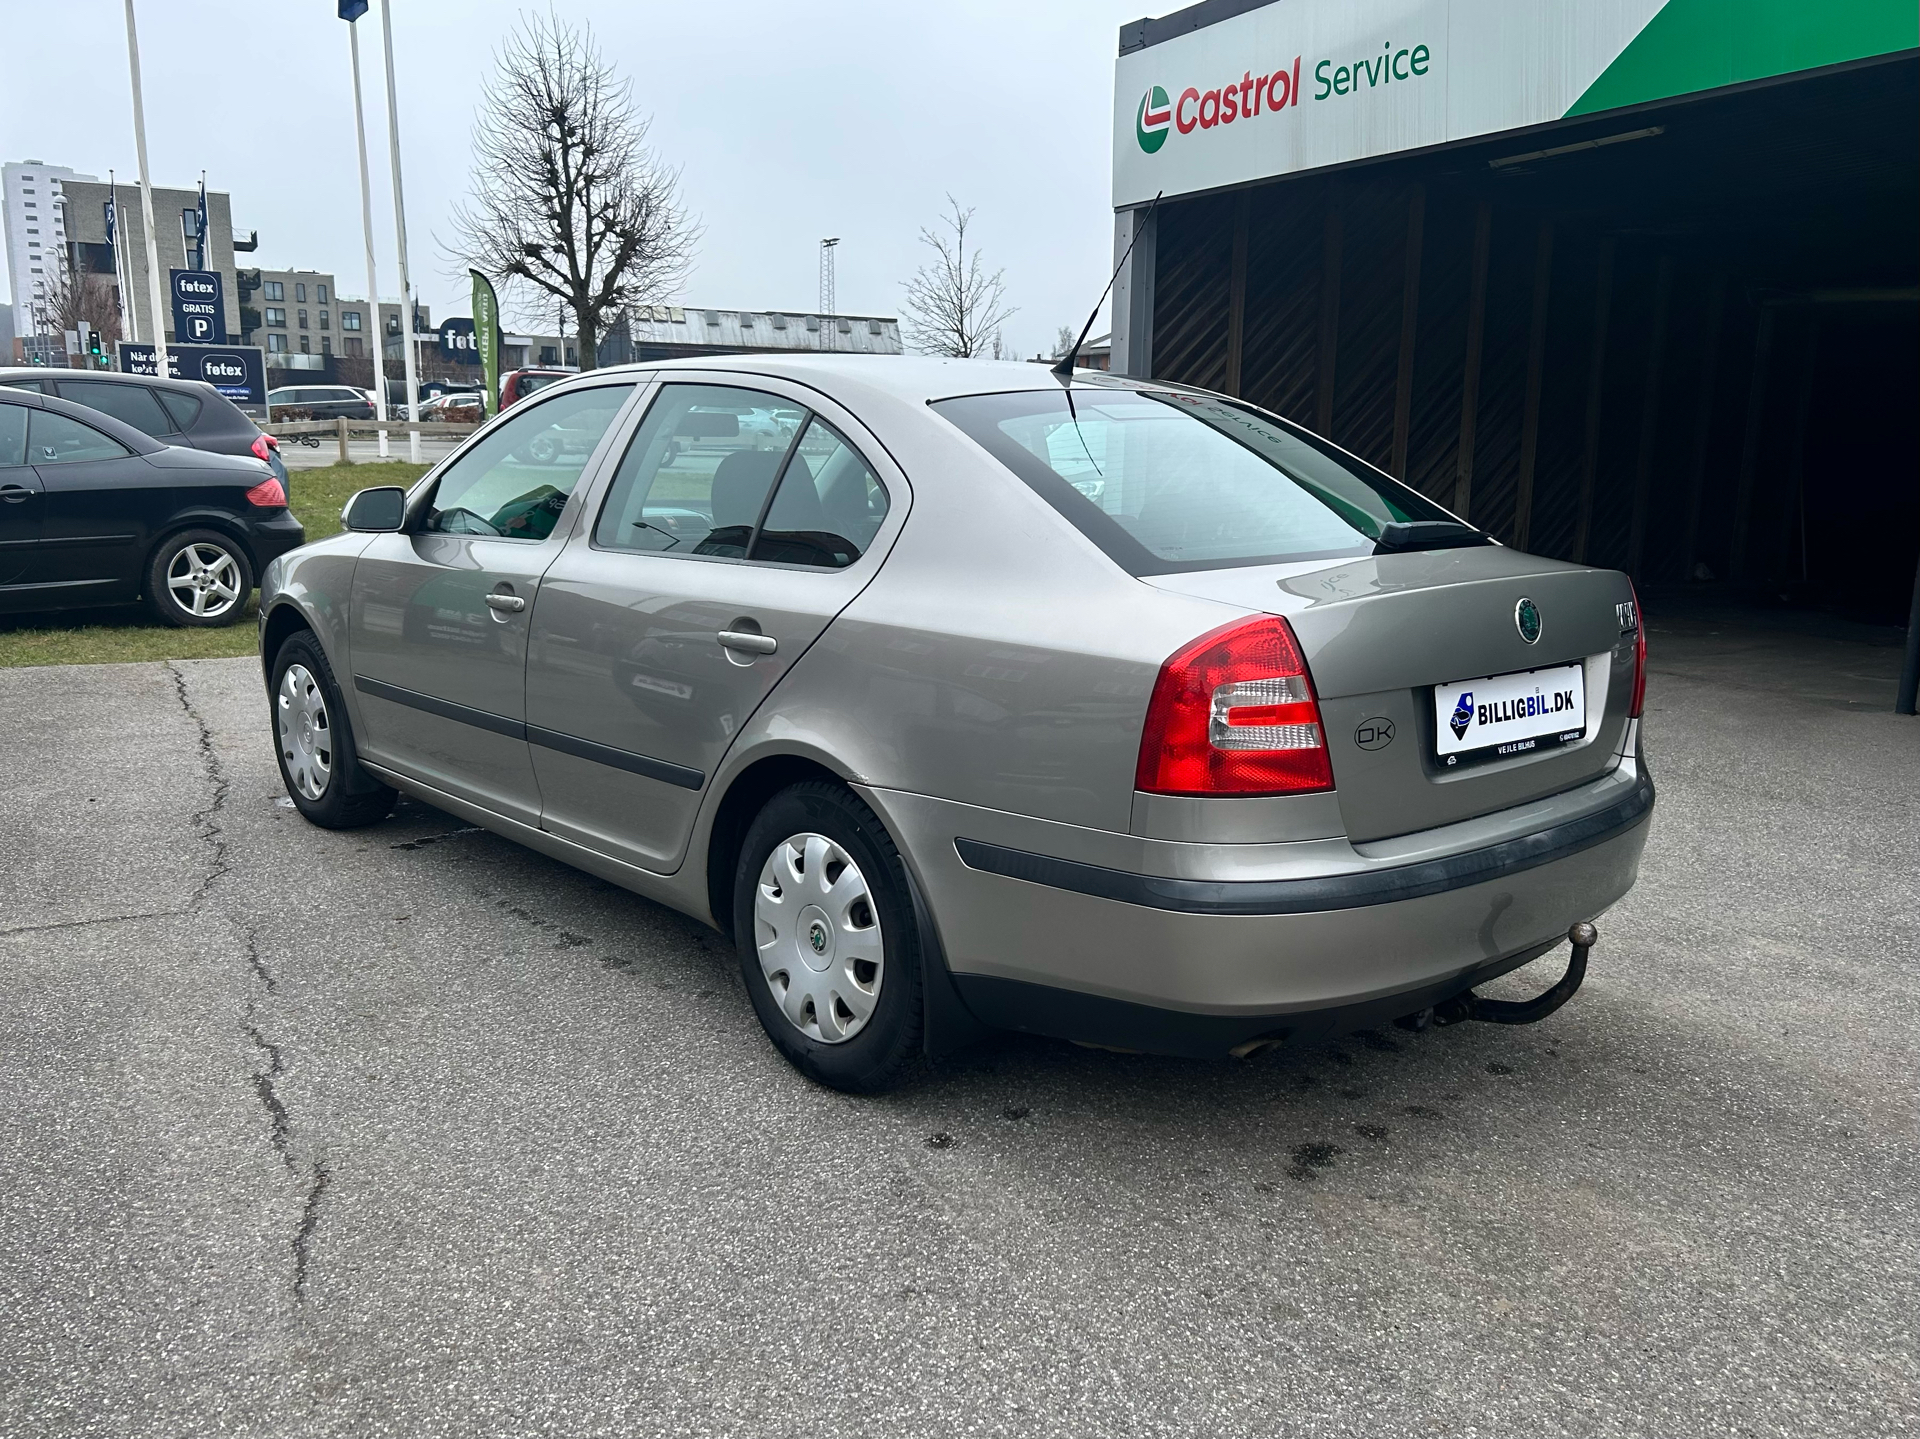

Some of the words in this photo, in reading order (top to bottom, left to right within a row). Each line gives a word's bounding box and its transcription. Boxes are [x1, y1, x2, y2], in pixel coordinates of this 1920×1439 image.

[1175, 54, 1302, 135] Castrol
[1314, 41, 1430, 101] Service
[182, 303, 215, 314] GRATIS
[194, 319, 208, 337] P
[445, 329, 477, 350] føt
[130, 351, 147, 361] Når
[205, 362, 242, 377] føtex
[1477, 690, 1575, 726] BILLIGBIL.DK
[1498, 743, 1517, 754] VEJLE
[1517, 740, 1536, 751] BILHUS
